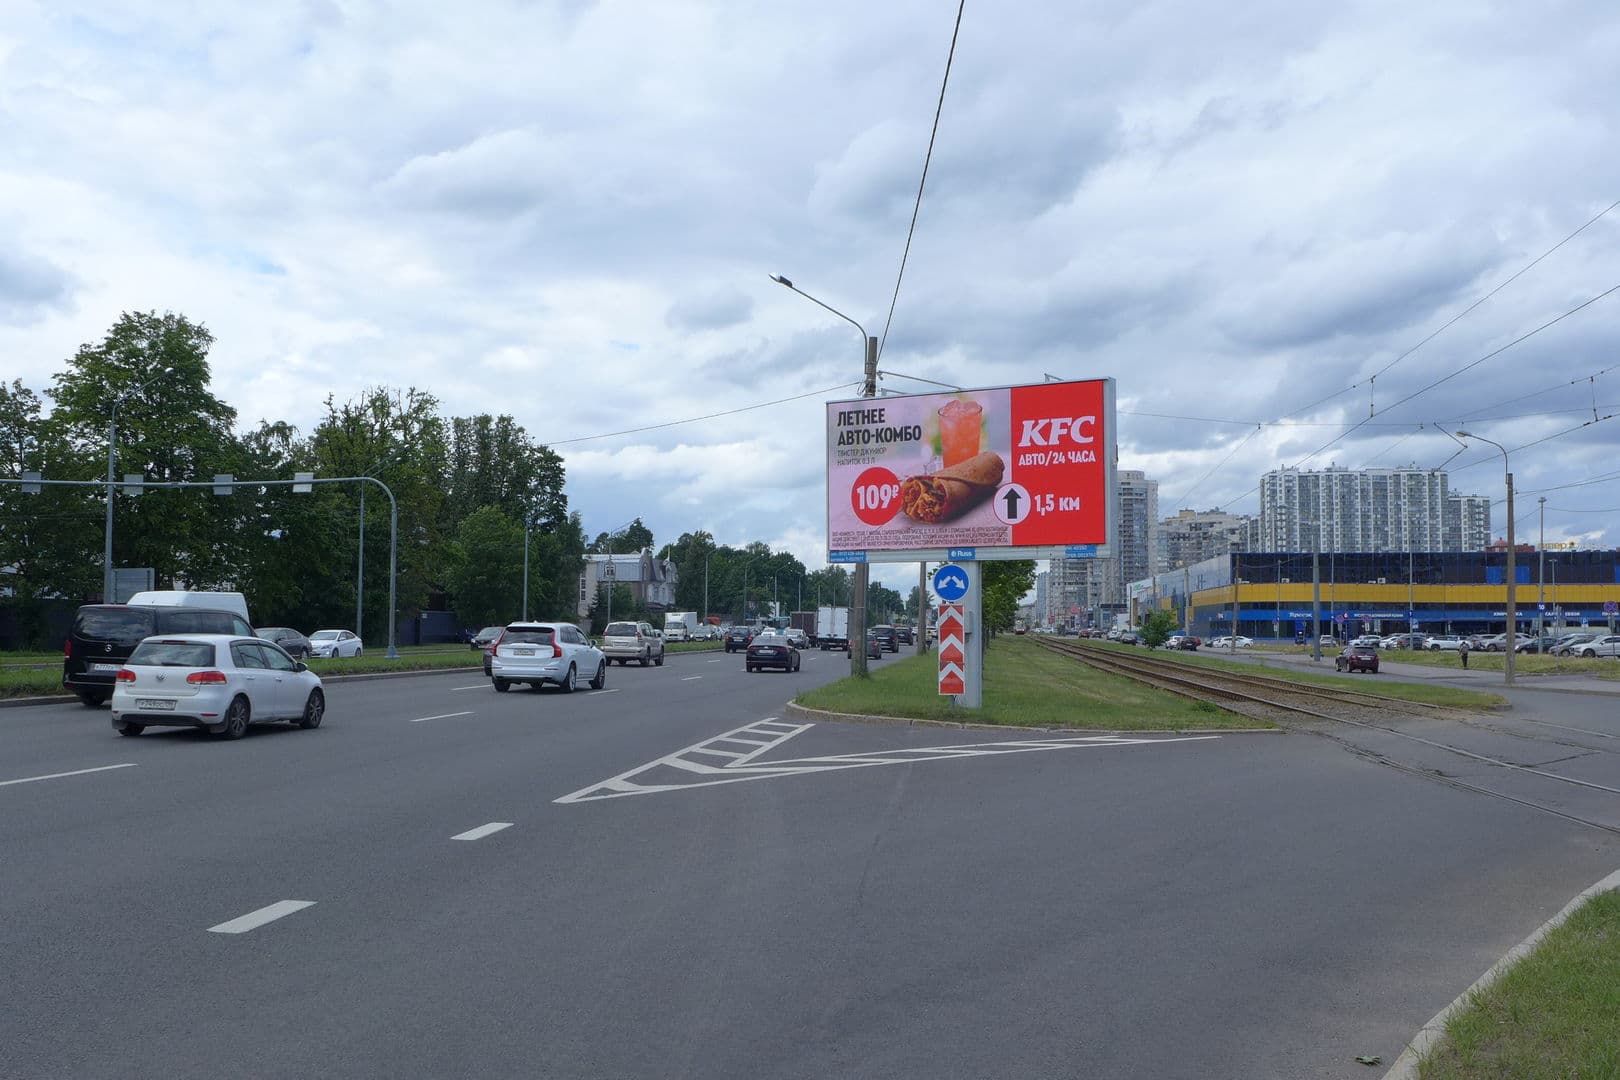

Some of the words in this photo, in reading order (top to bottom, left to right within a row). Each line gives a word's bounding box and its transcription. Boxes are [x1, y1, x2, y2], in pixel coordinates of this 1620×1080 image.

[837, 408, 886, 427] ЛЕТНЕЕ
[837, 424, 922, 447] АВТО-КОМБО
[1018, 415, 1096, 447] KFC
[1018, 450, 1066, 466] АВТО/24
[1067, 450, 1096, 464] ЧАСА
[1034, 494, 1055, 516] 1,5
